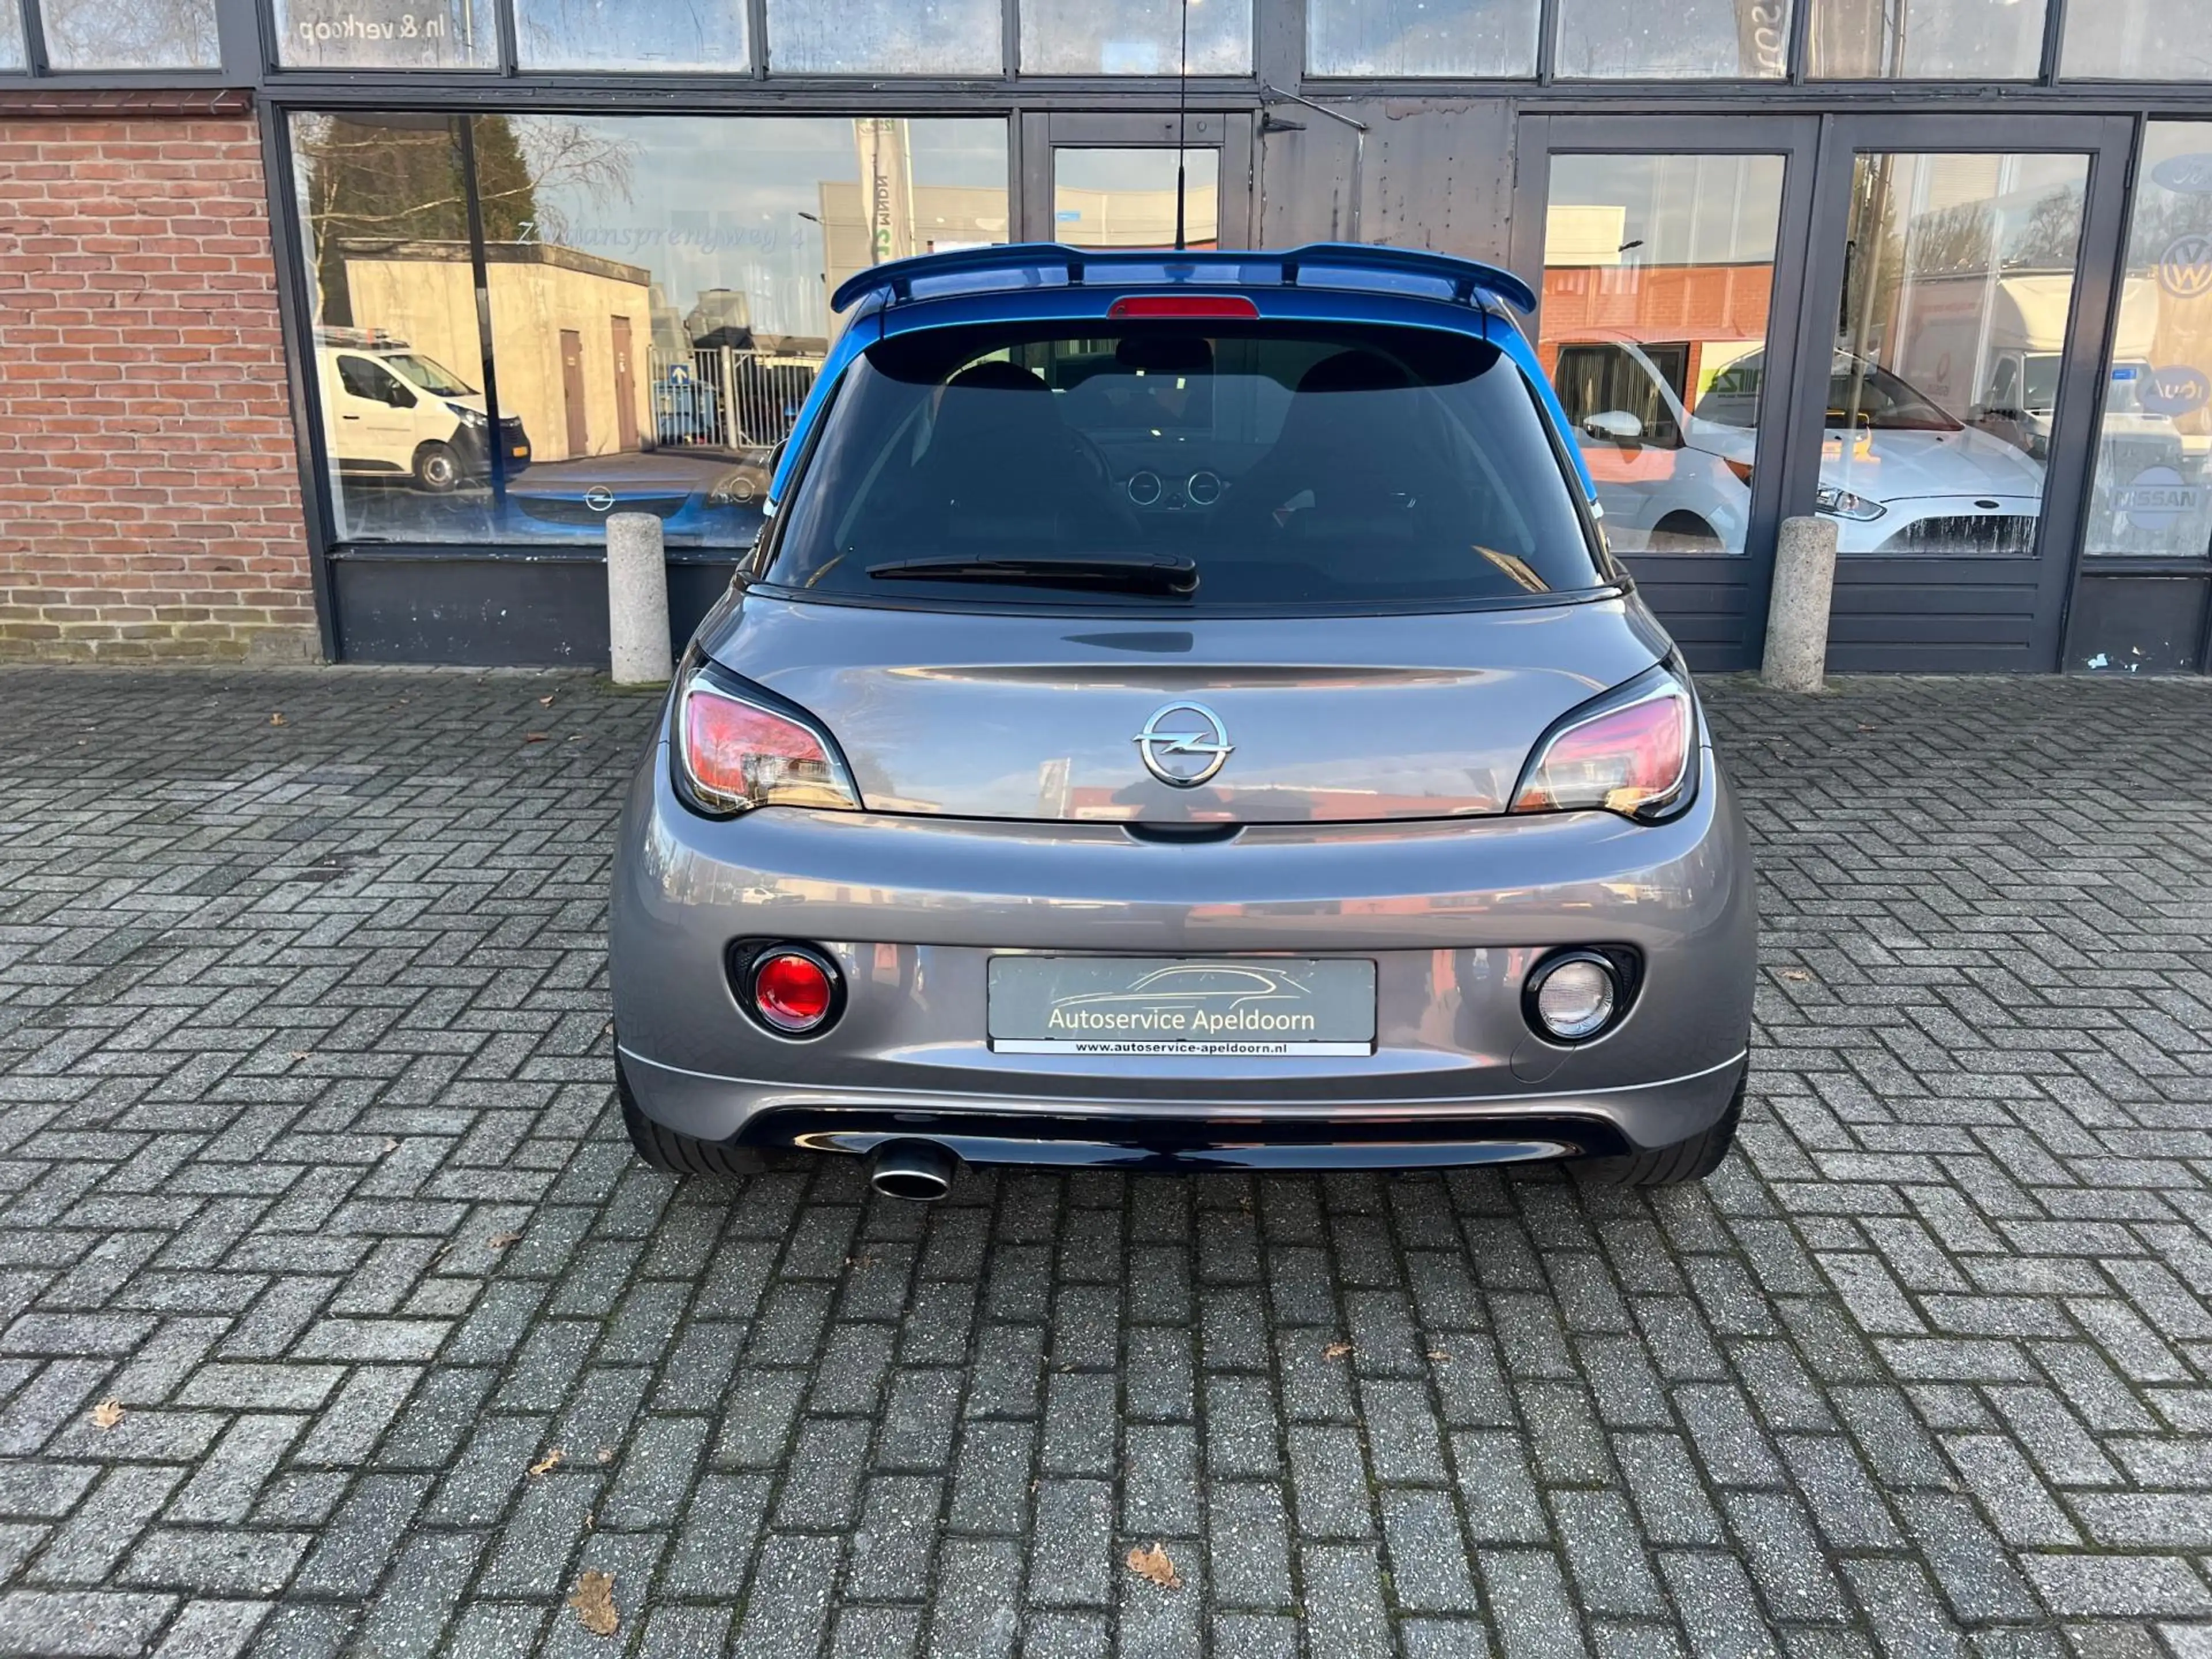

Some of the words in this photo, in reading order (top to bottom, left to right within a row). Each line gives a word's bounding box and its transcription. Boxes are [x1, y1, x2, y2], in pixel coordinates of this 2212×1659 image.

[2114, 491, 2197, 507] NISSAN
[1048, 1008, 1185, 1029] Autoservice
[1192, 1008, 1315, 1035] Apeldoorn
[1076, 1043, 1287, 1054] www.autoservice-apeldoorn.nl
